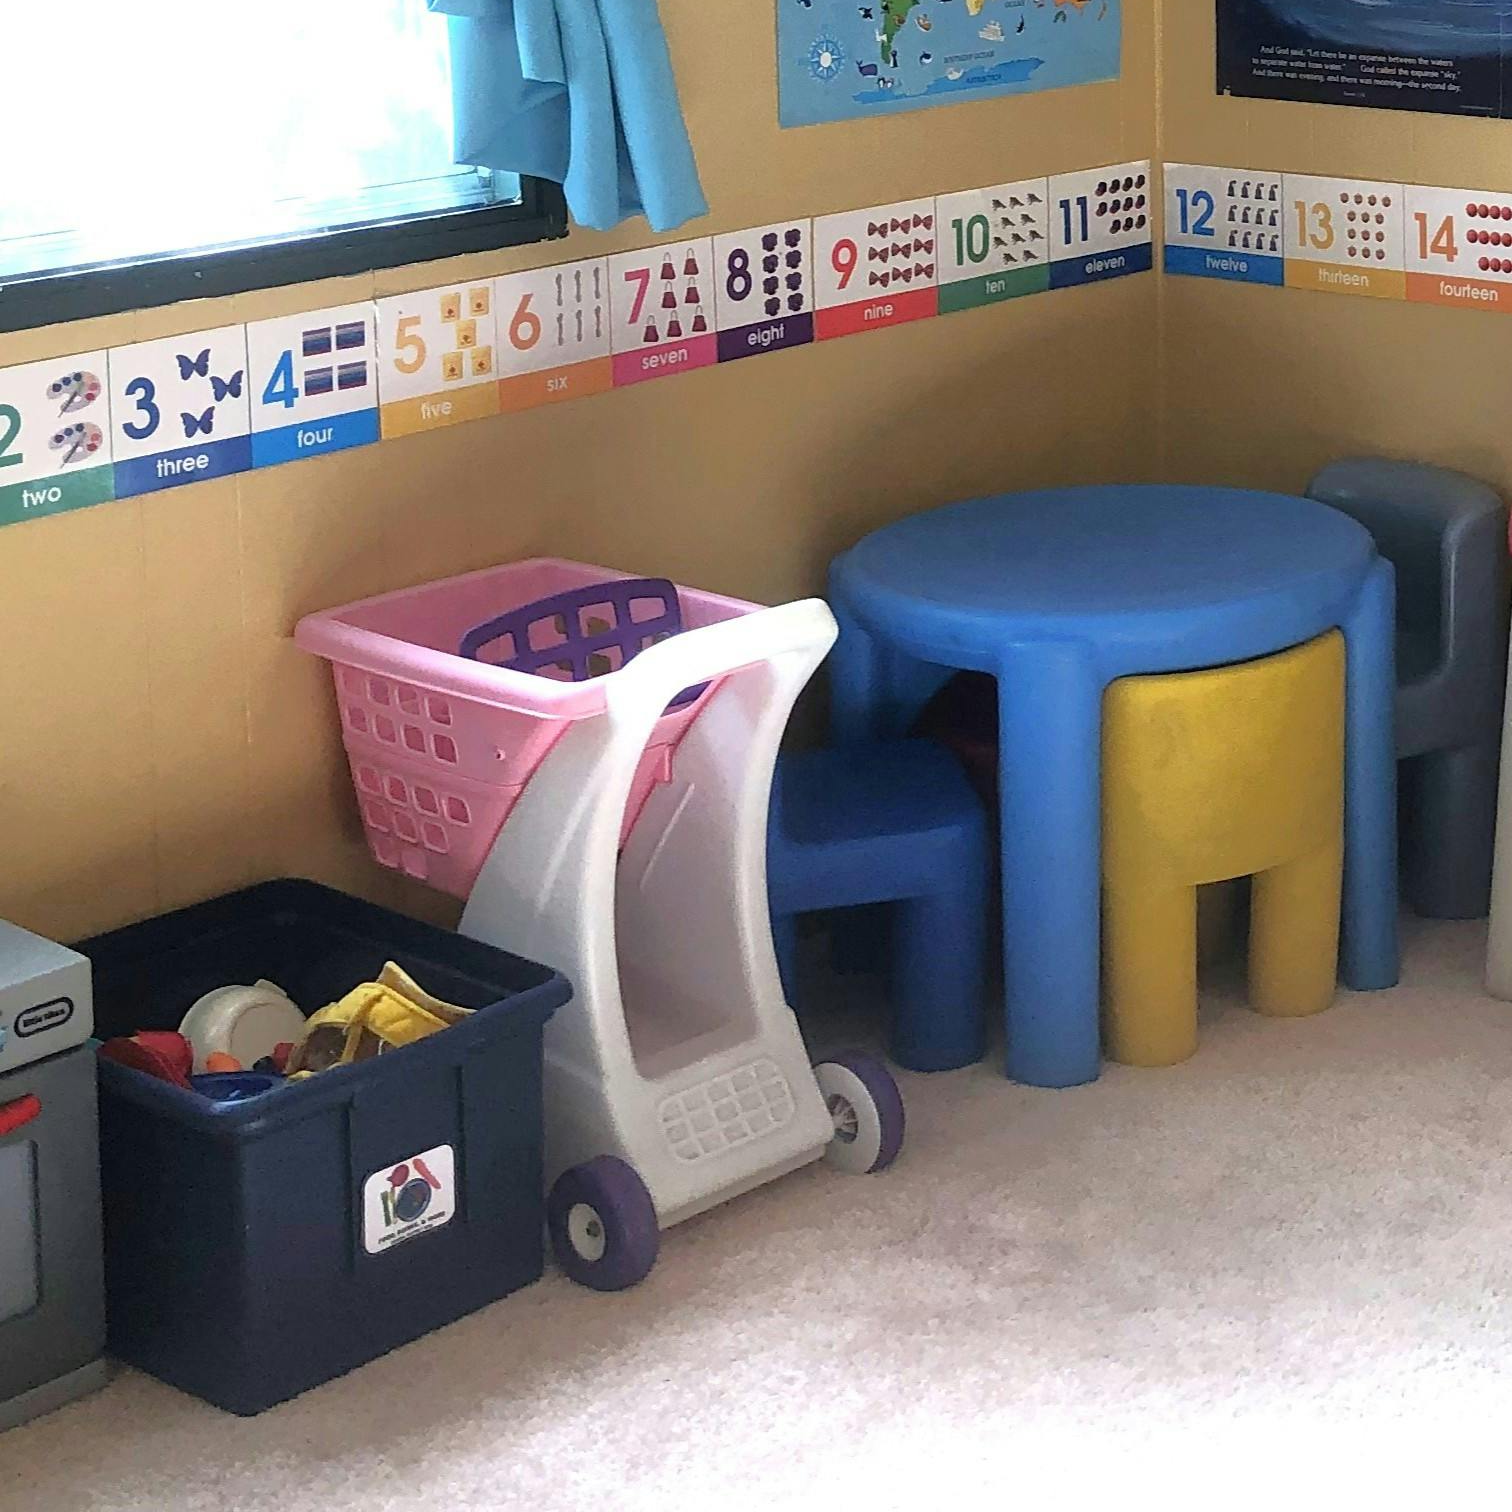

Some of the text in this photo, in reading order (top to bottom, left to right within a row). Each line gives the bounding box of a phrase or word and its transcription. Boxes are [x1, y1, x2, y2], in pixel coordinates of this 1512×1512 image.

[1059, 196, 1088, 245] 11
[1176, 188, 1215, 237] 12
[1294, 200, 1335, 250] 13
[952, 214, 989, 266] 10
[1414, 212, 1458, 262] 14
[726, 249, 752, 302] 8
[831, 238, 857, 290] 9
[1085, 255, 1125, 275] eleven
[1205, 255, 1248, 274] twelve
[1318, 268, 1369, 288] thirteen
[624, 268, 650, 325] 7
[985, 280, 1006, 295] ten
[1440, 281, 1498, 301] fourteen
[509, 293, 541, 350] 6
[864, 303, 893, 321] nine
[394, 316, 426, 374] 5
[748, 324, 785, 347] eight
[641, 349, 688, 369] seven
[262, 349, 299, 408] 4
[547, 377, 568, 392] six
[122, 377, 160, 439] 3
[420, 401, 453, 420] five
[0, 403, 23, 468] 2
[298, 426, 333, 447] four
[156, 453, 209, 478] three
[22, 487, 62, 508] two
